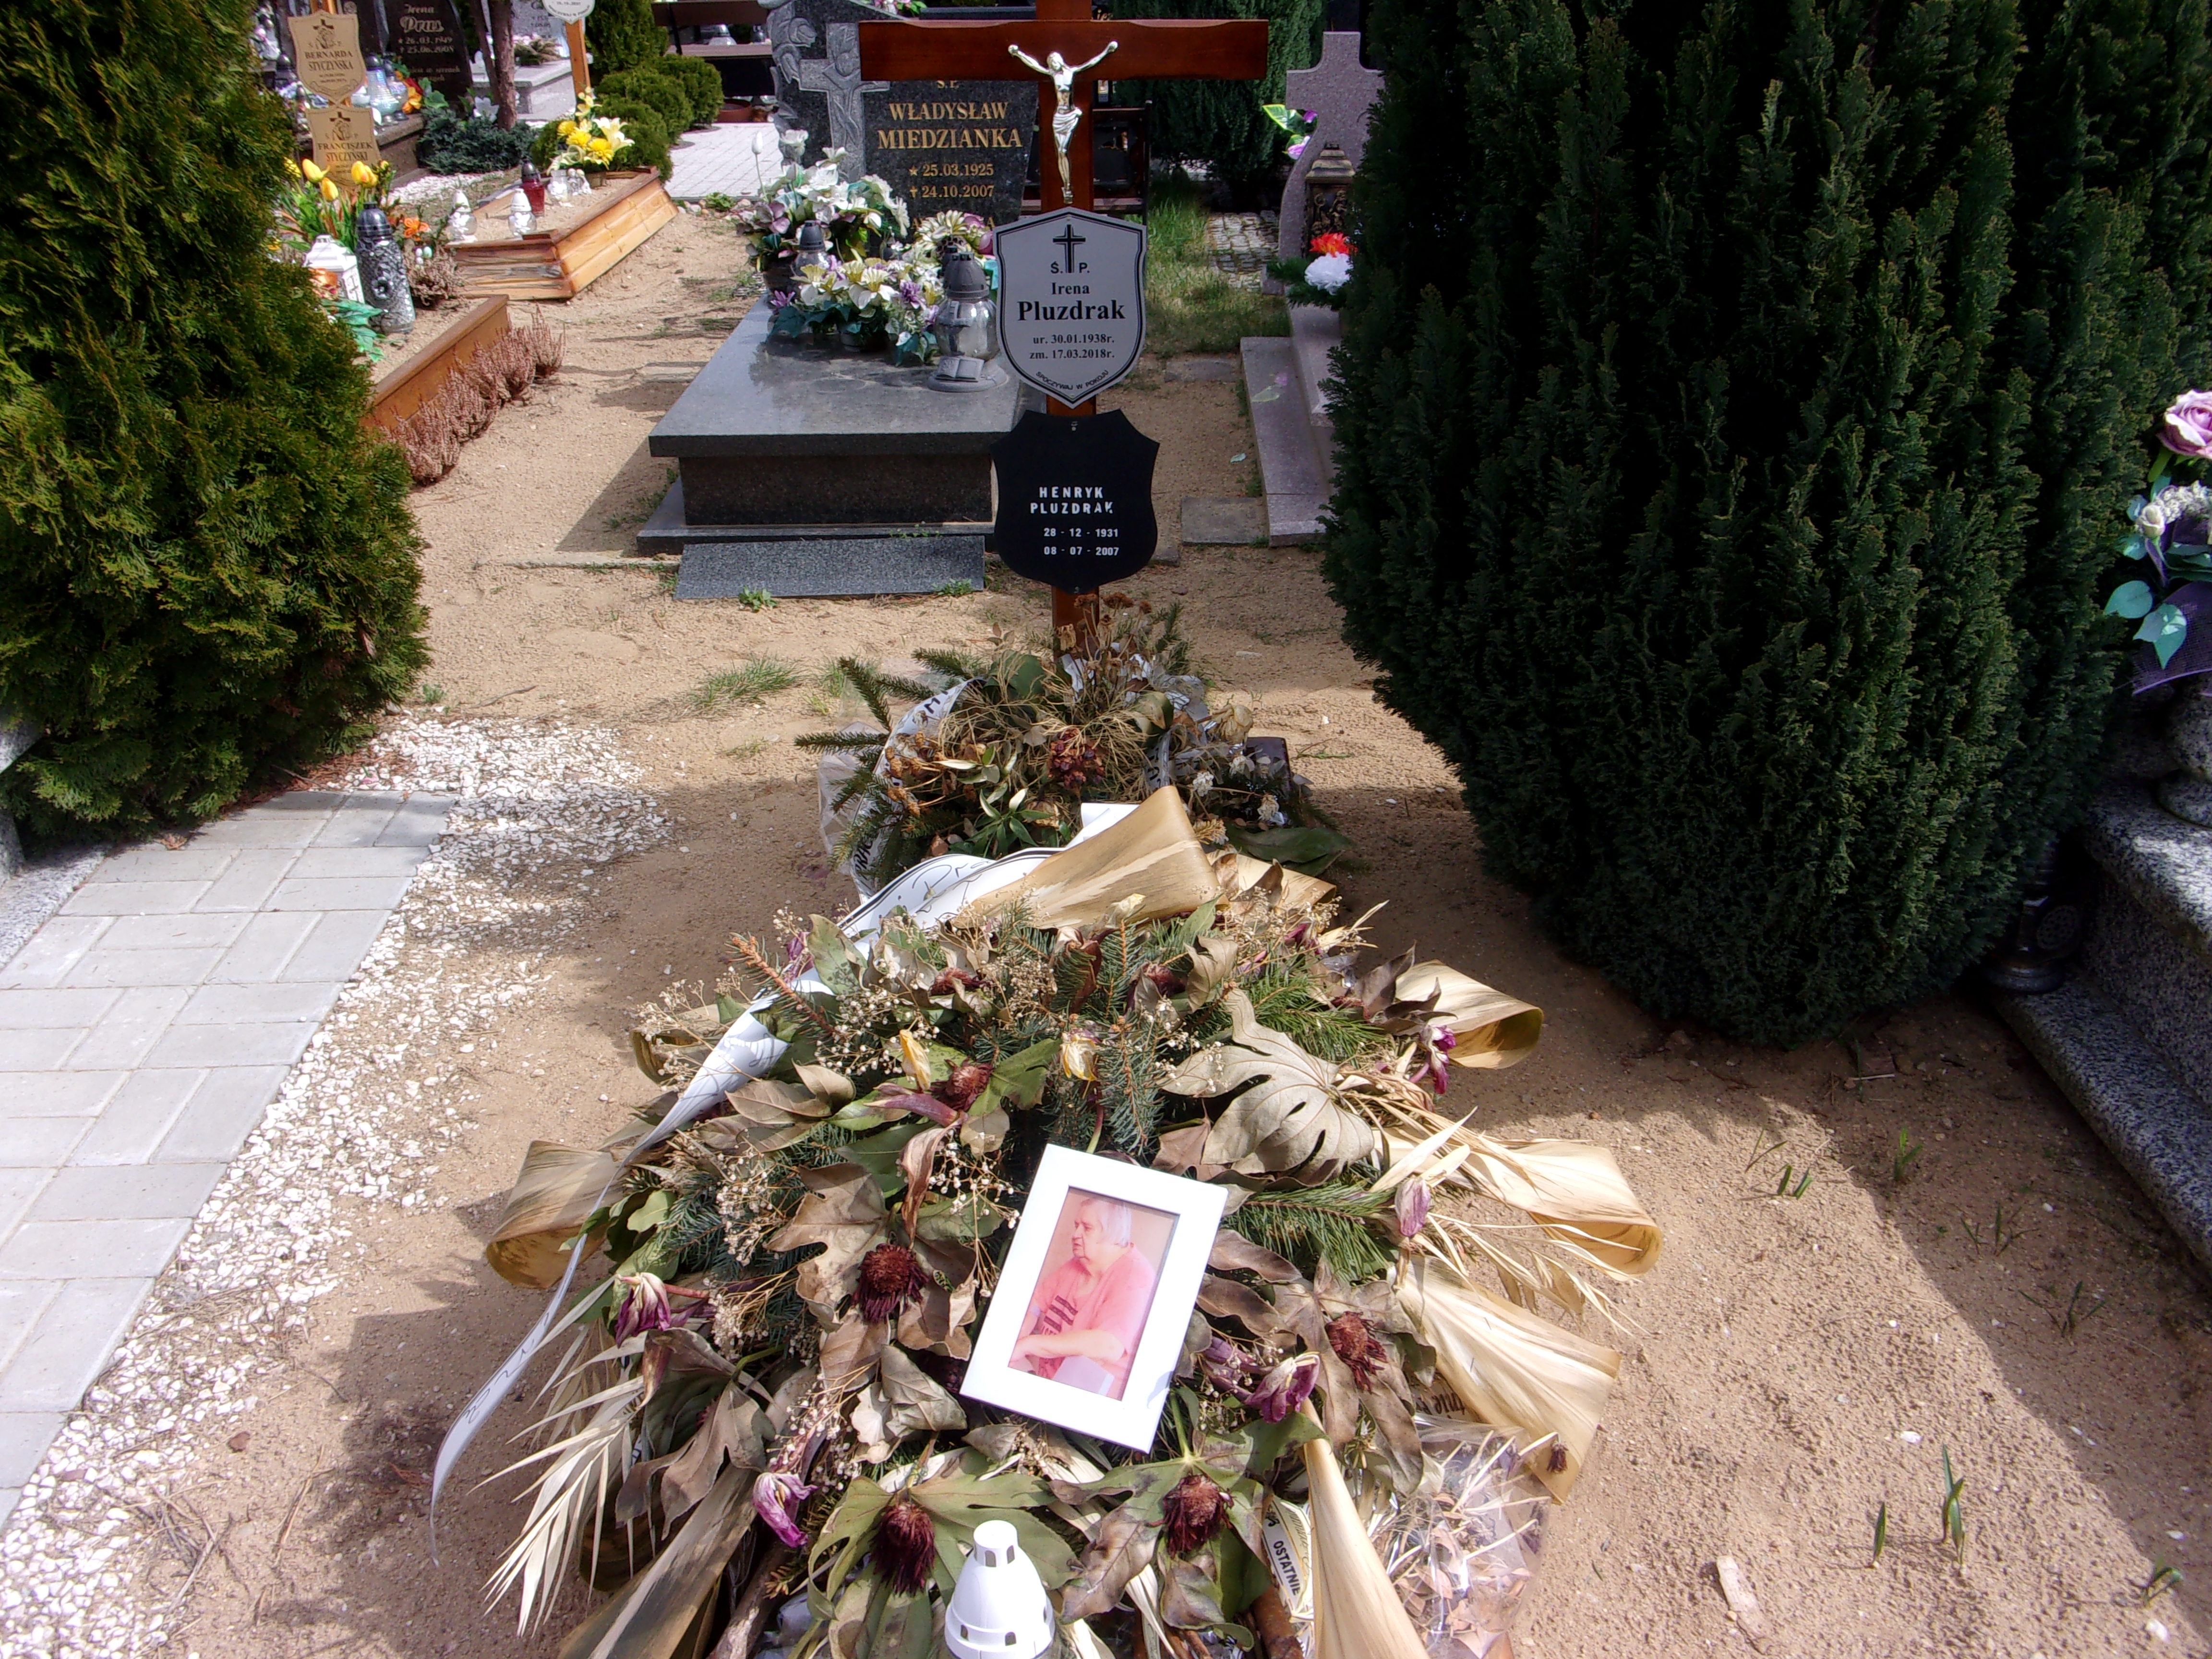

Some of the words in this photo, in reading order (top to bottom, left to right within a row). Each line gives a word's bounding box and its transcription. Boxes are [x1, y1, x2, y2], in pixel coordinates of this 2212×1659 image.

[304, 50, 353, 59] BERNARDA
[889, 102, 1008, 120] WŁADYSŁAW
[878, 128, 1023, 149] MIEDZIANKA
[317, 142, 373, 150] FRANCISZEK
[922, 164, 995, 177] 25.03.1925
[922, 185, 995, 198] 24.10.2007
[1079, 262, 1090, 274] P.
[1051, 282, 1090, 295] Irena
[1017, 300, 1126, 321] Pluzdrak
[1033, 336, 1048, 344] ur.
[1051, 334, 1115, 344] 30.01.1938r.
[1029, 351, 1048, 360] zm.
[1052, 349, 1115, 359] 17.03.2018r.
[1035, 371, 1073, 390] SPOCZYWAJ
[1085, 369, 1109, 388] POKOJU
[1039, 486, 1104, 499] HENRYK
[1030, 502, 1113, 515] PLUZDRAK
[1043, 528, 1057, 537] 28
[1069, 528, 1082, 537] 12
[1094, 529, 1118, 538] 1931
[1044, 546, 1058, 555] 08
[1069, 546, 1083, 555] 07
[1095, 547, 1119, 556] 2007
[1273, 1540, 1300, 1596] OSTATNIE
